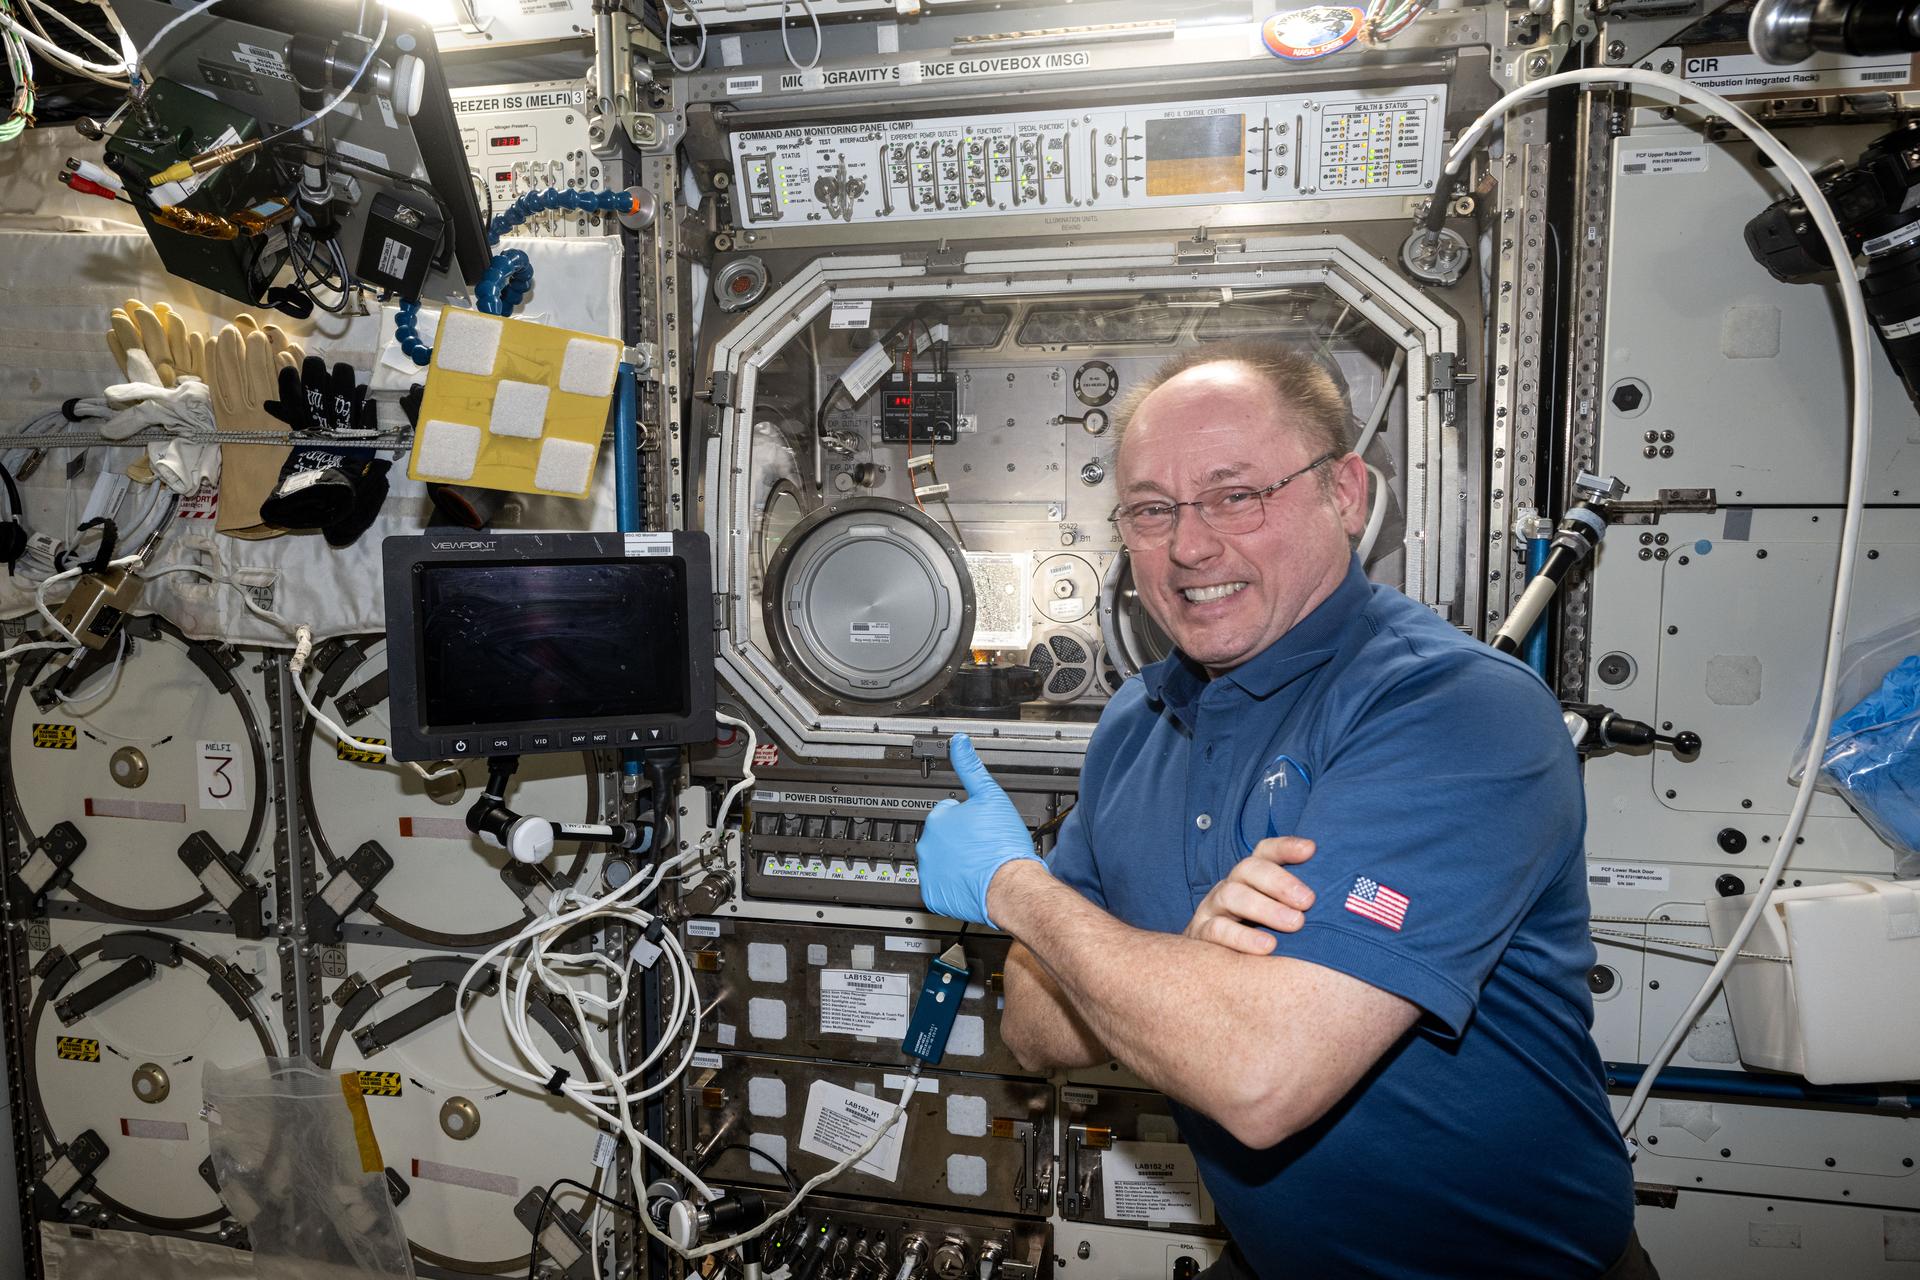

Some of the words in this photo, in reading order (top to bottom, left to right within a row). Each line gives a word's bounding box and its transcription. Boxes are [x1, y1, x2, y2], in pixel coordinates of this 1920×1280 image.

[254, 66, 279, 77] DESK
[782, 68, 888, 89] MICGRAVITY
[892, 63, 955, 80] SENCE
[959, 55, 1041, 75] GLOVEBOX
[1046, 54, 1090, 68] (MSG)
[1687, 58, 1718, 73] CIR
[1688, 77, 1742, 88] Combustion
[1745, 75, 1791, 86] Integrated
[452, 99, 499, 112] REEZER
[503, 97, 522, 109] ISS
[526, 93, 571, 108] (MELFI)
[574, 92, 582, 103] 3
[739, 131, 782, 141] COMMAND
[784, 129, 802, 137] AND
[805, 125, 858, 136] MONITORING
[860, 124, 888, 132] PANEL
[889, 122, 914, 131] (CMP)
[205, 743, 232, 752] MELFI
[205, 756, 233, 798] 3
[785, 794, 816, 803] POWER
[818, 796, 878, 806] DISTRIBUTION
[880, 798, 899, 807] AND
[901, 799, 938, 809] CONVER
[844, 974, 885, 983] LAB1S2_G1
[844, 1099, 880, 1119] LAB1S2_H1
